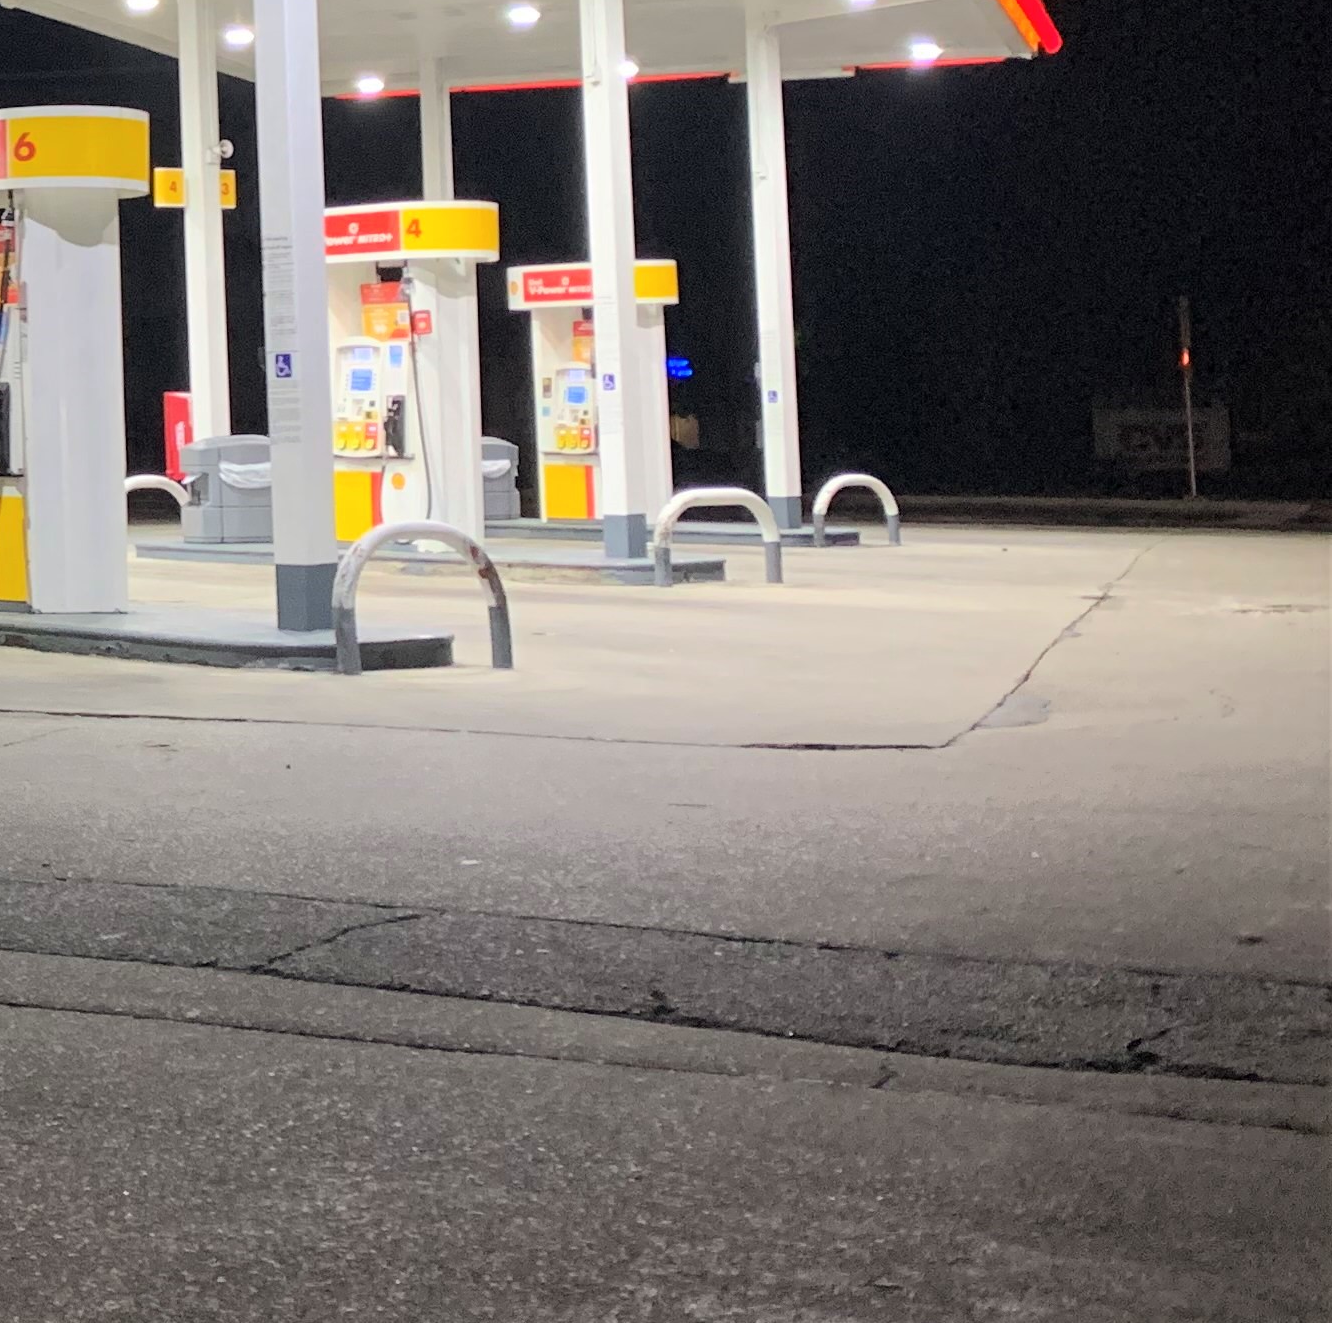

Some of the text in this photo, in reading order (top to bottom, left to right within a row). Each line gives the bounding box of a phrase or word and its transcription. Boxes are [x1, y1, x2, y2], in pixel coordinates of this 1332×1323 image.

[14, 132, 37, 162] 6
[169, 180, 177, 193] 4
[221, 182, 229, 195] 3
[406, 219, 422, 238] 4
